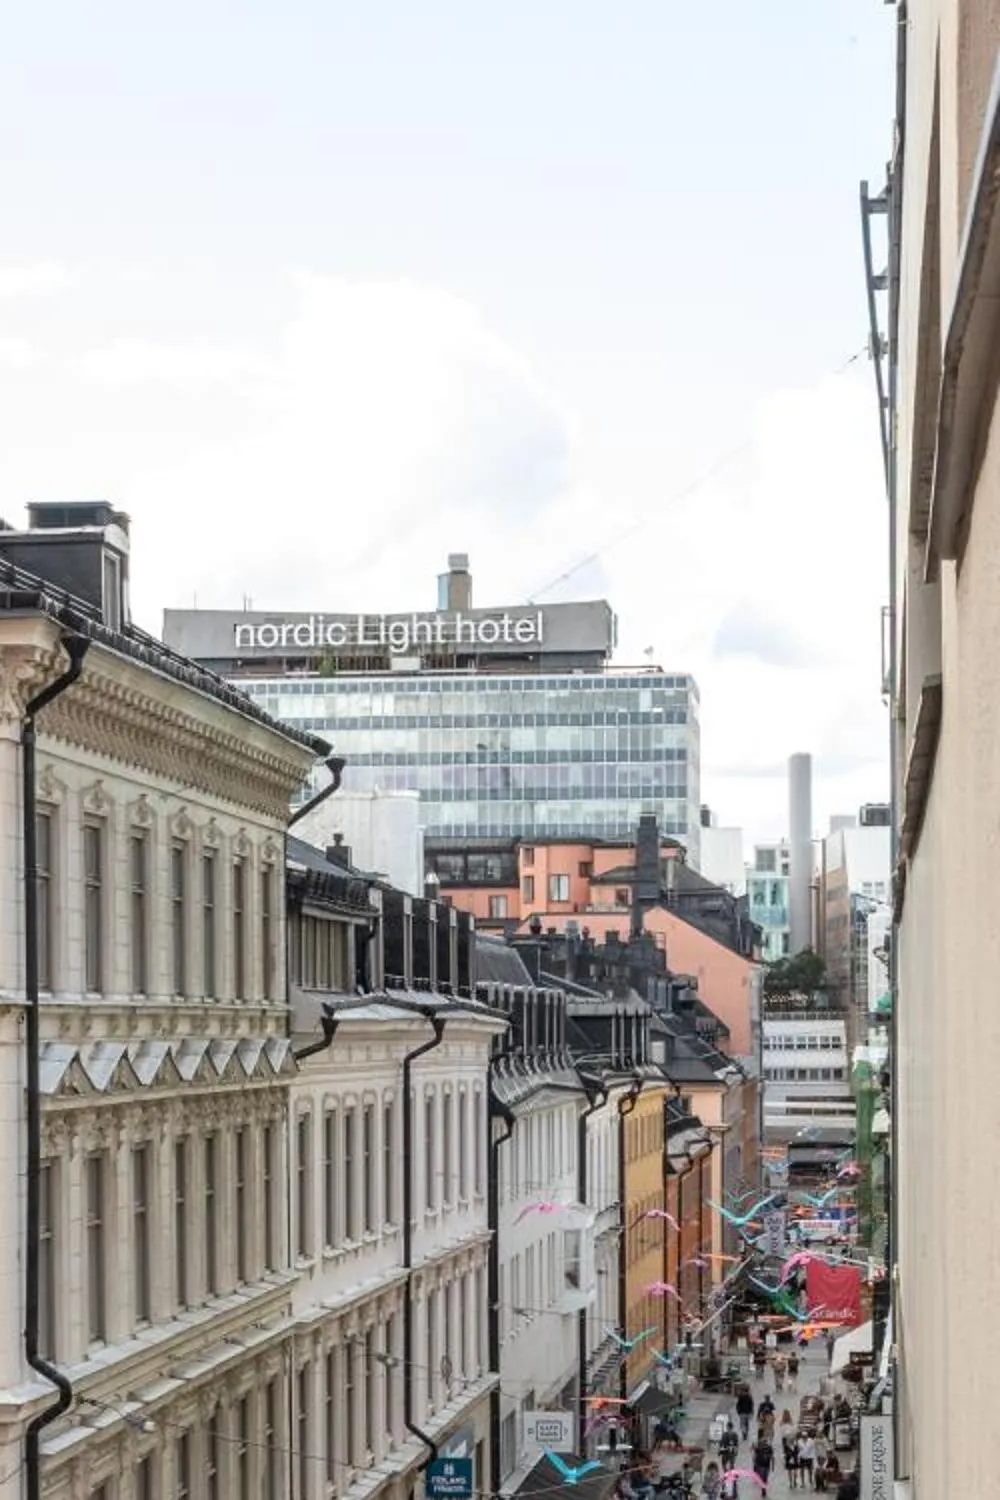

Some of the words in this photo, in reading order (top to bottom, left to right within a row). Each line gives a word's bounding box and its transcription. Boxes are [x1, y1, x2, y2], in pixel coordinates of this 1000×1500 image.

[235, 614, 346, 648] nordic
[358, 612, 446, 653] Light
[456, 610, 543, 643] hotel
